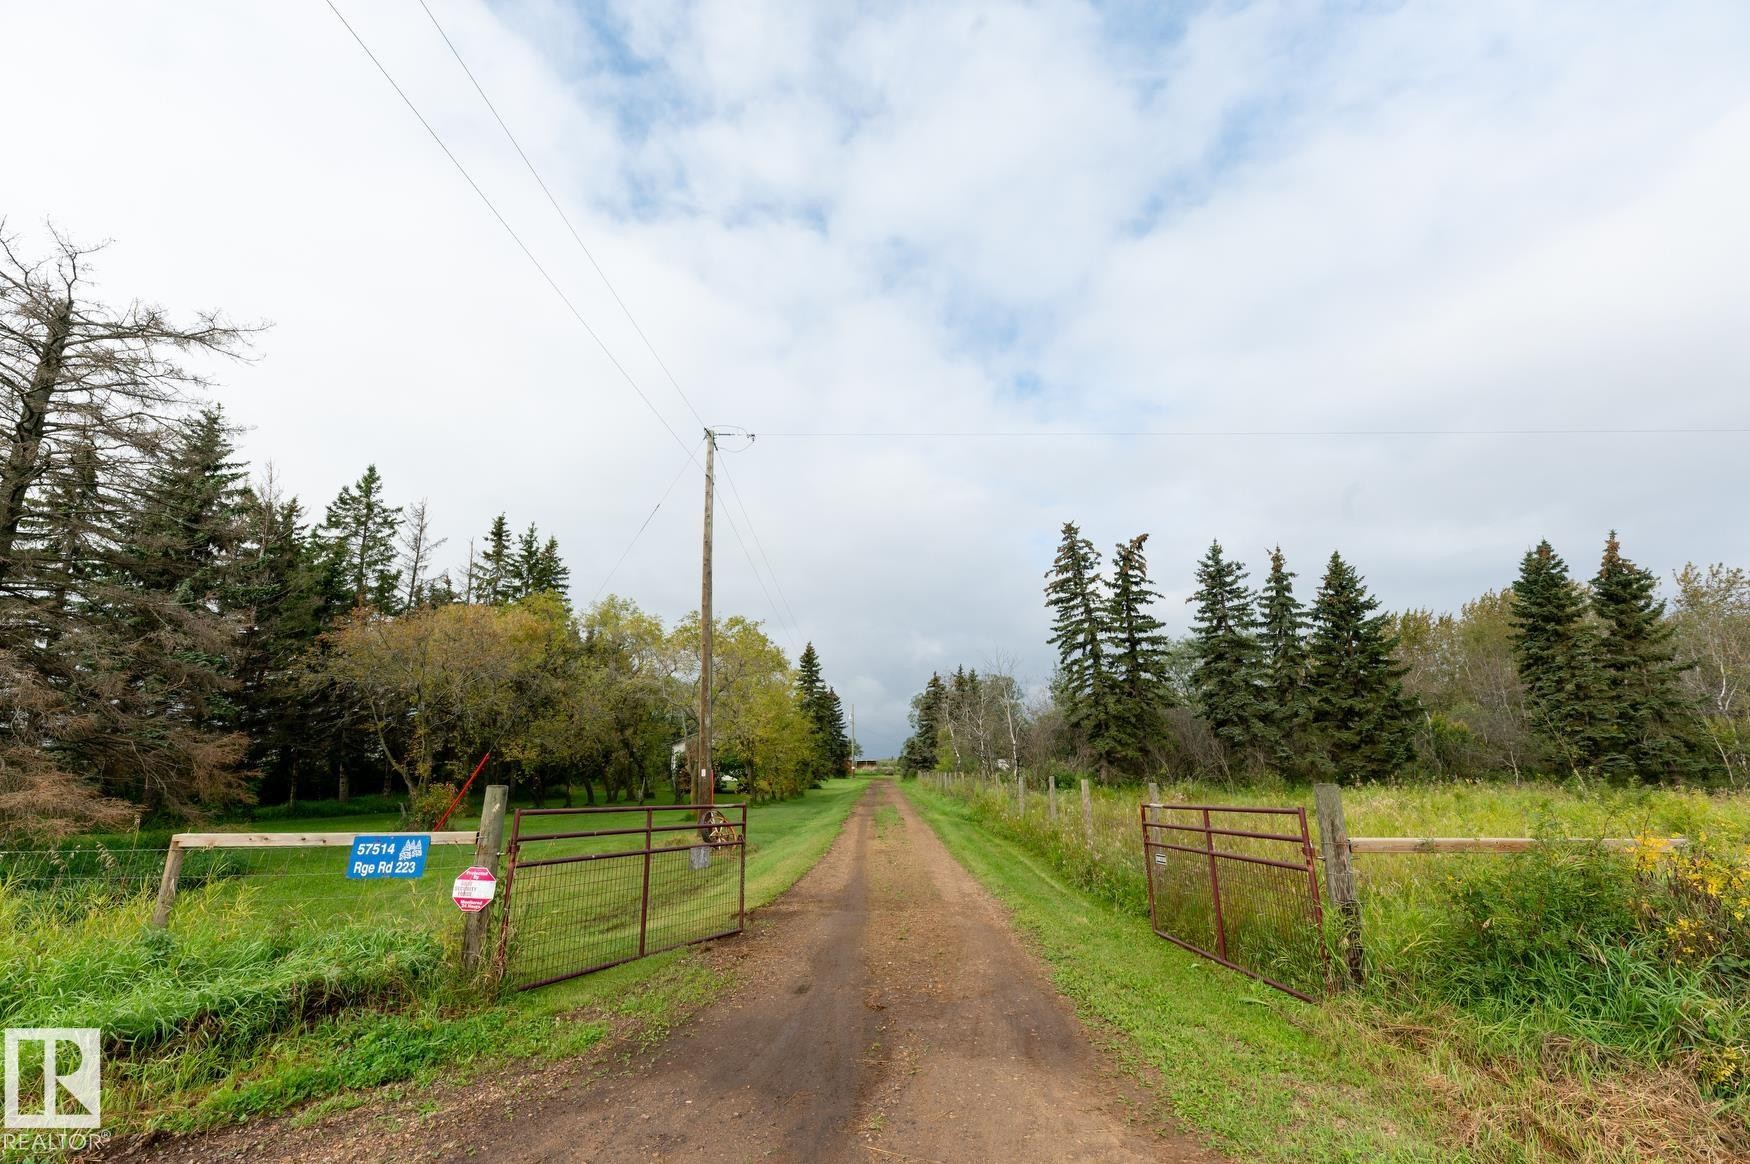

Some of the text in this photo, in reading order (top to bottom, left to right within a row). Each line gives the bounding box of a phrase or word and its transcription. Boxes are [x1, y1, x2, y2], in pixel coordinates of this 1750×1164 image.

[357, 843, 395, 855] 57514
[353, 861, 416, 877] Rge Rd 223
